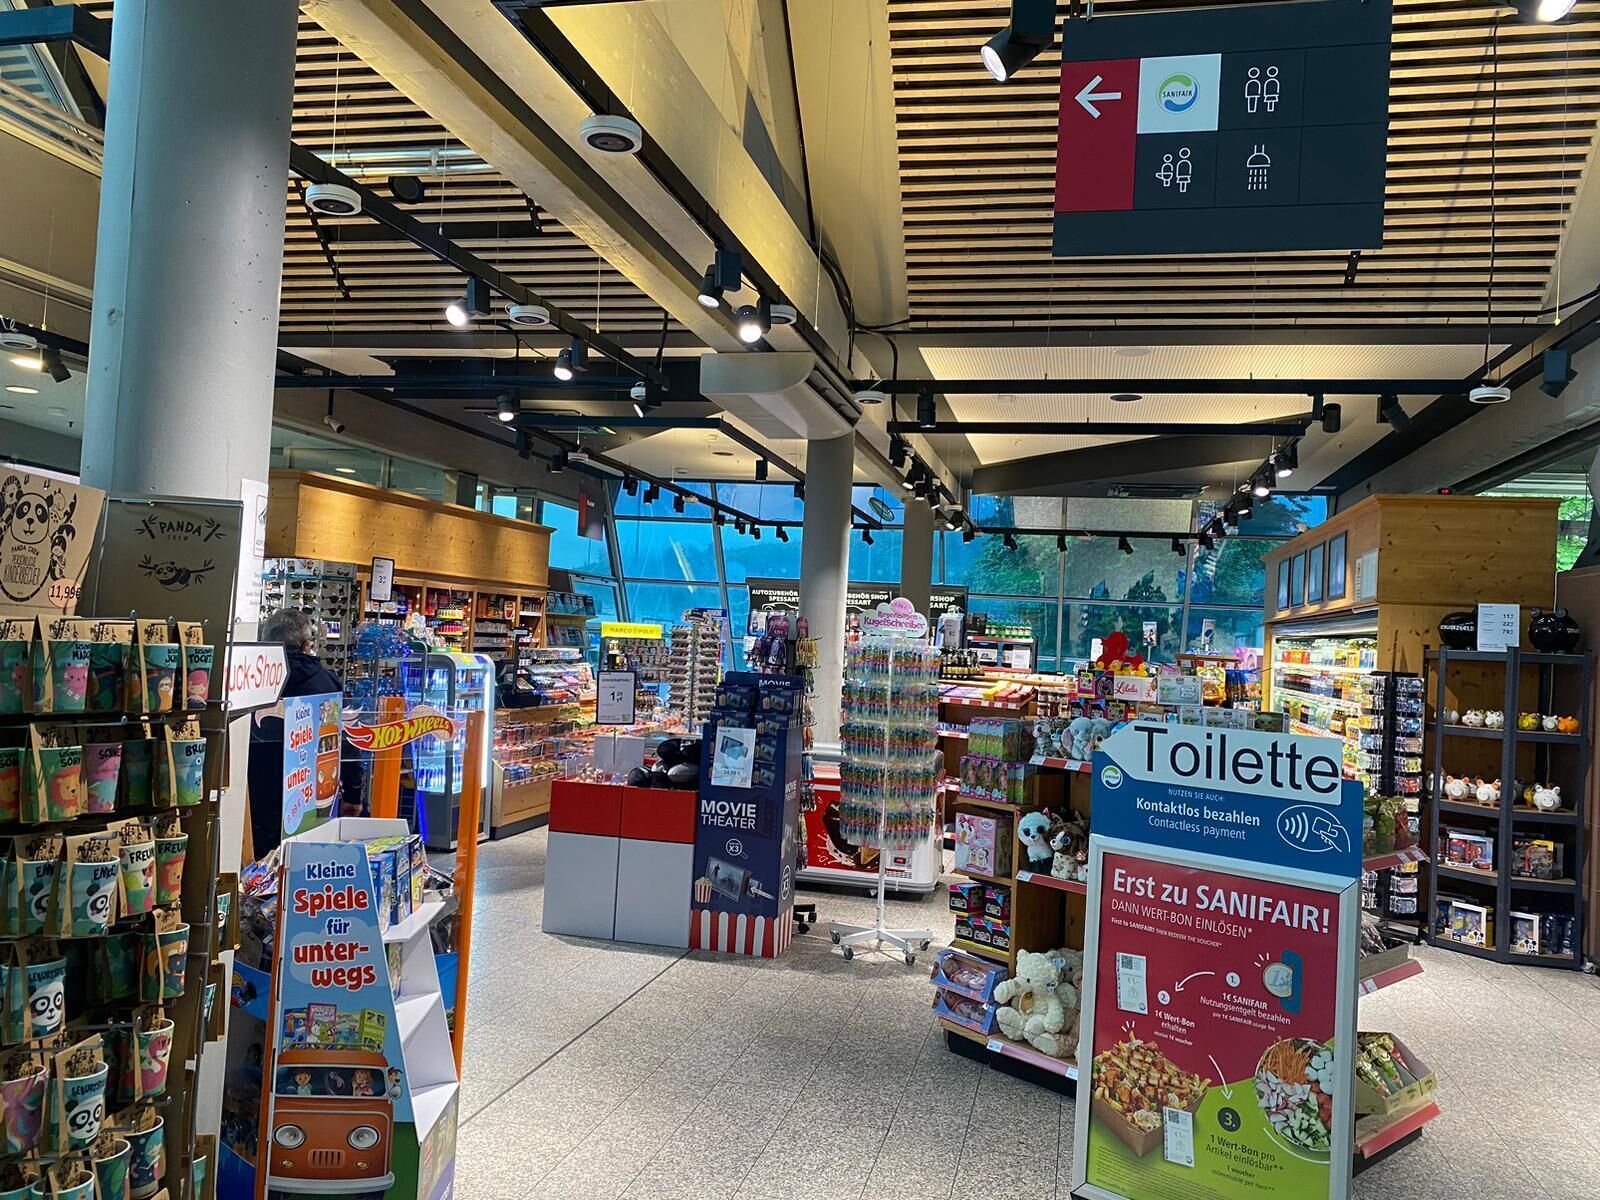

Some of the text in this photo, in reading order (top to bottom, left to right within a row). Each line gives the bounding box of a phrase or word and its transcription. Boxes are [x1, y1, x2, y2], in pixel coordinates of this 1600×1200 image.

[1162, 90, 1193, 98] SANIFAIR
[159, 520, 202, 537] PANDA
[751, 589, 799, 597] AUTOZUBEHÖR
[870, 593, 889, 601] SHOP
[223, 654, 284, 695] uck-Shop
[296, 706, 311, 722] Kleine
[289, 725, 313, 751] Spiele
[1134, 726, 1340, 794] Toilette
[287, 766, 311, 790] unter-
[1168, 788, 1193, 798] NUTZEN
[701, 799, 756, 818] MOVIE
[1136, 797, 1260, 826] Kontaktlos bezahlen
[701, 814, 756, 830] THEATER
[1148, 815, 1247, 840] Contactless payment
[728, 845, 740, 853] X3
[305, 861, 356, 881] Kleine
[293, 884, 370, 919] Spiele
[1113, 868, 1331, 934] Erst zu SANIFAIR!
[1111, 898, 1140, 915] DANN
[1141, 905, 1193, 928] WERT-BON
[325, 917, 351, 936] für
[1111, 917, 1123, 926] First
[1155, 928, 1168, 936] THEN
[1187, 935, 1196, 943] THE
[293, 940, 370, 965] unter-
[310, 964, 377, 992] wegs
[1199, 995, 1292, 1026] Nutzungsentgelt bezahlen
[1222, 992, 1269, 1010] 1€ SANIFAIR
[1154, 1009, 1196, 1029] 1€ Wert-Bon
[1161, 1020, 1188, 1035] erhalten
[1223, 1111, 1236, 1128] 3.
[1205, 1143, 1233, 1160] Artikel
[1216, 1135, 1259, 1158] Wert-Bon
[1260, 1151, 1276, 1163] pro
